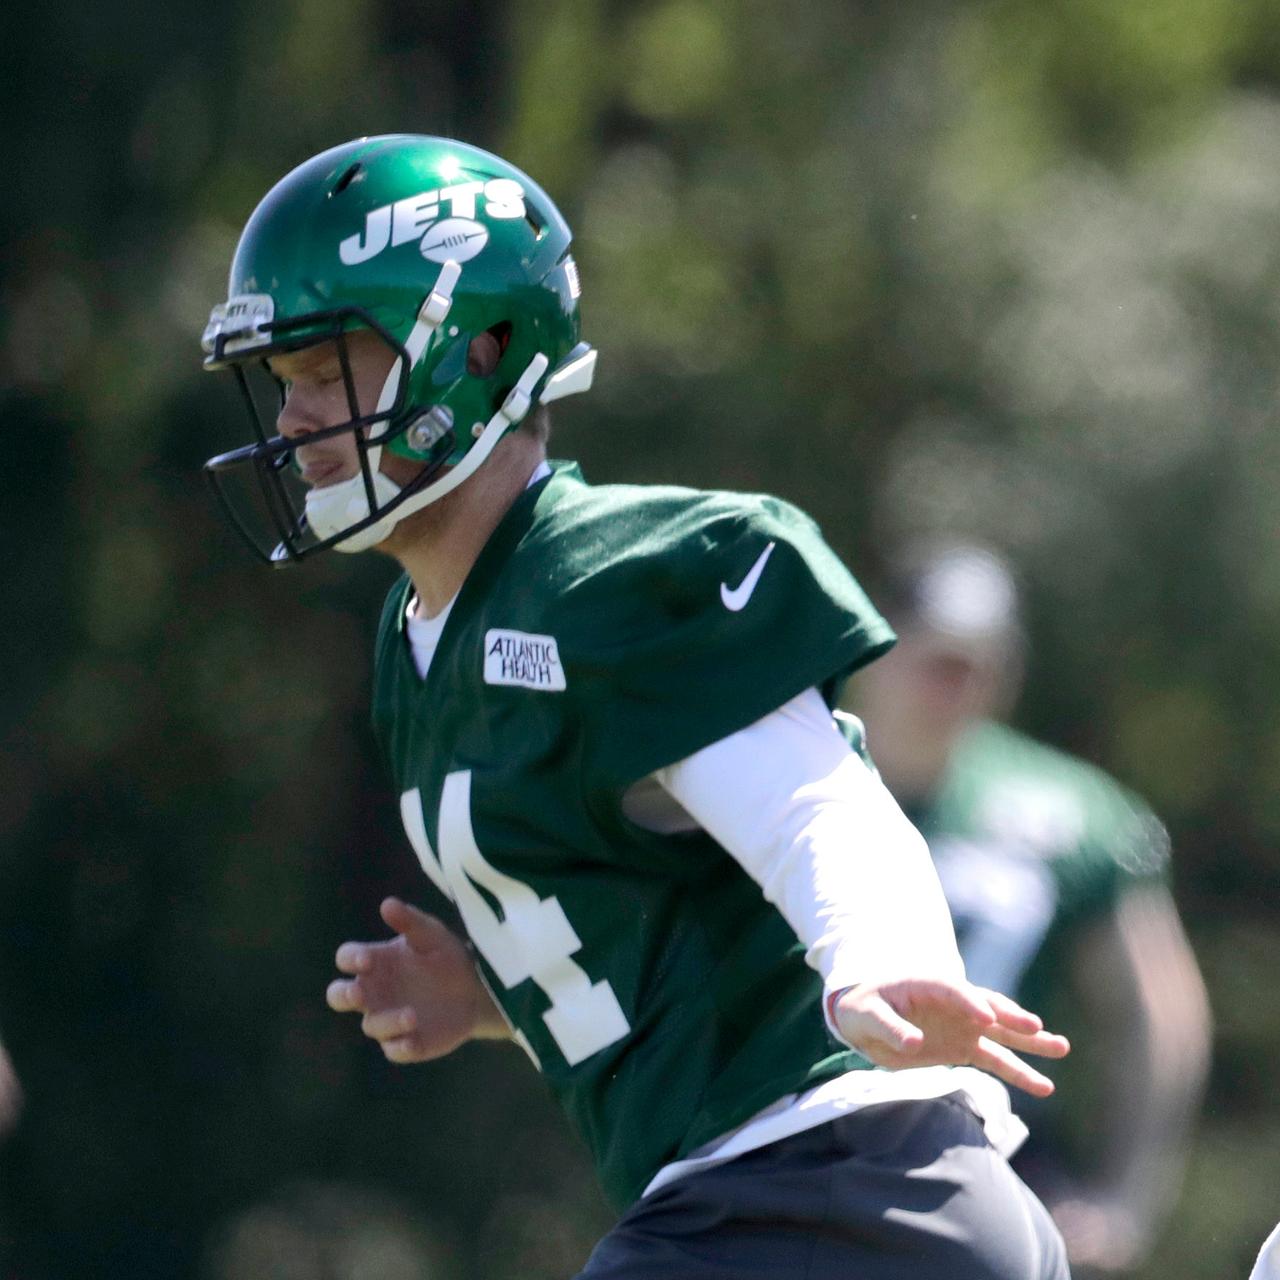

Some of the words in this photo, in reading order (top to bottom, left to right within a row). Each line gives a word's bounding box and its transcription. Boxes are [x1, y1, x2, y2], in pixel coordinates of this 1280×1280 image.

[339, 177, 527, 266] JETS
[488, 636, 557, 664] ATLANTIC
[502, 658, 551, 684] HEALTH
